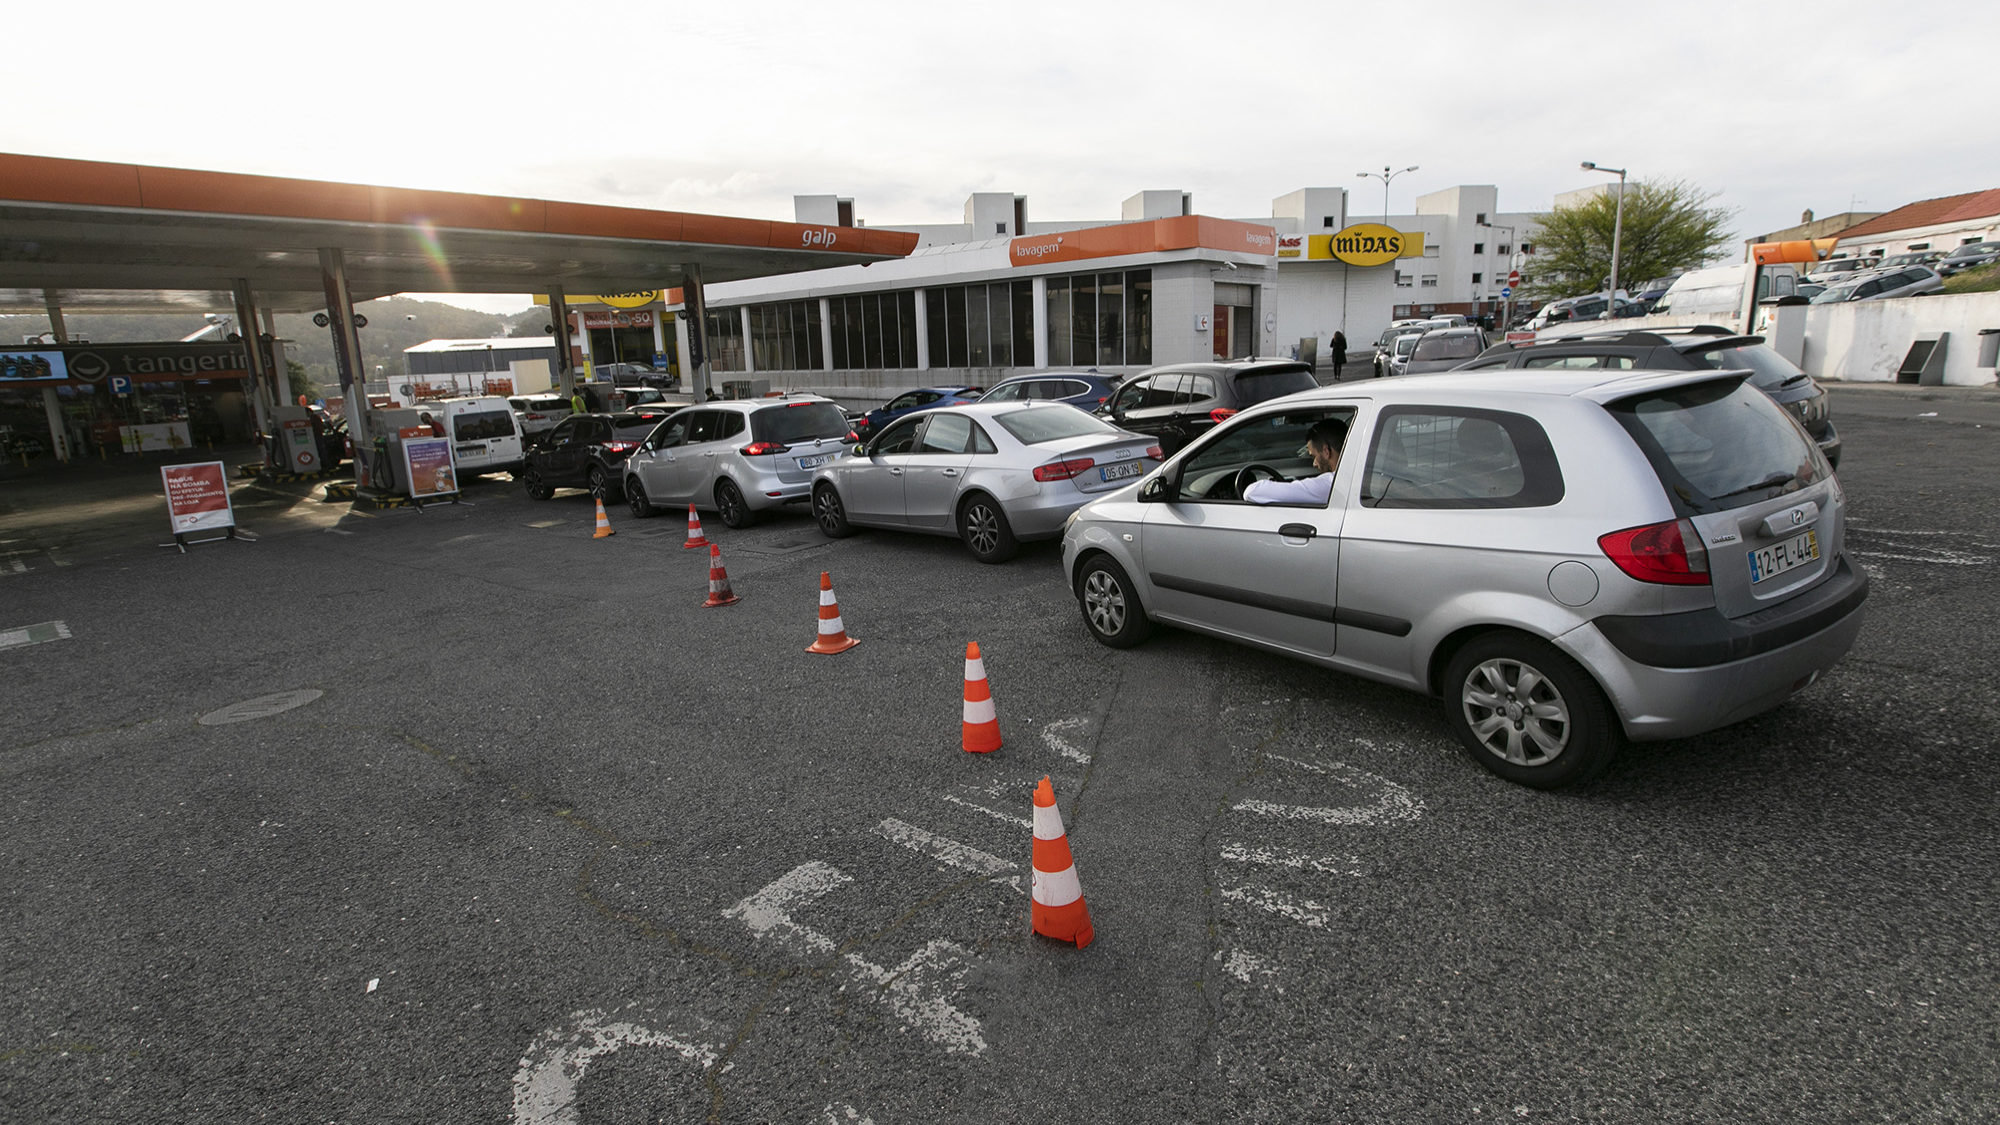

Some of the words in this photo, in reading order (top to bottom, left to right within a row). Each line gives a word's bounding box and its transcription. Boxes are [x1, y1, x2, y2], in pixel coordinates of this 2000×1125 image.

[802, 228, 837, 248] galp
[1246, 231, 1271, 247] lavagem
[1336, 235, 1400, 254] MIDAS
[1017, 242, 1059, 257] lavagem
[112, 378, 125, 392] P
[182, 480, 210, 488] BOMBA
